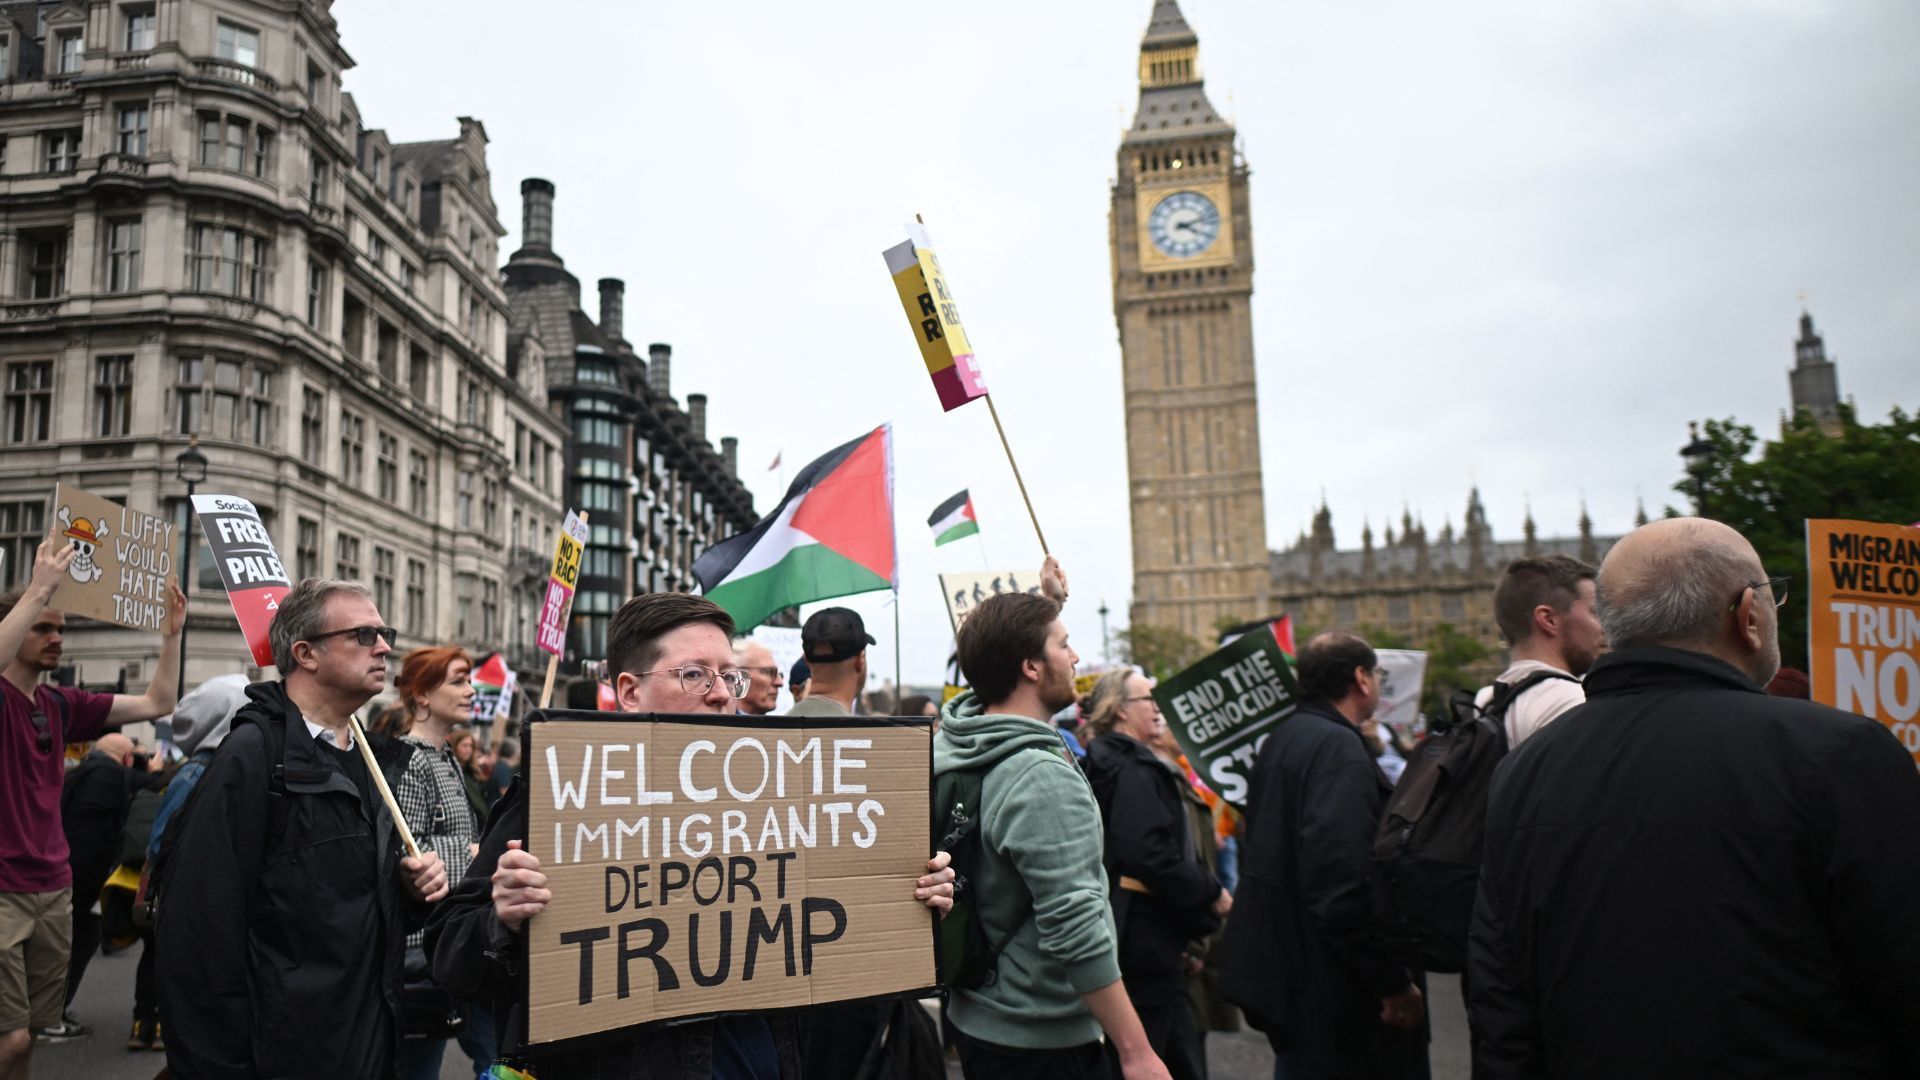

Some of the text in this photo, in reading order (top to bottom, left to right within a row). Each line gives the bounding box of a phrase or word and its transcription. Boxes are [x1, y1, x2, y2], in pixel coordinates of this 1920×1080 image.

[120, 507, 173, 548] LUFFY
[115, 537, 170, 575] WOULD
[560, 537, 573, 560] NO
[120, 567, 166, 602] HATE
[225, 556, 289, 585] PALE
[1829, 561, 1919, 596] WELCO
[112, 594, 166, 631] TRUMP
[546, 602, 559, 626] TO
[549, 583, 564, 607] NO
[1171, 649, 1276, 724] END THE
[1834, 647, 1920, 722] NO
[1187, 676, 1290, 744] GENOCIDE
[546, 736, 872, 811] WELCOME
[554, 800, 885, 864] IMMIGRANTS
[605, 852, 797, 914] DEPORT
[560, 897, 848, 1006] TRUMP
